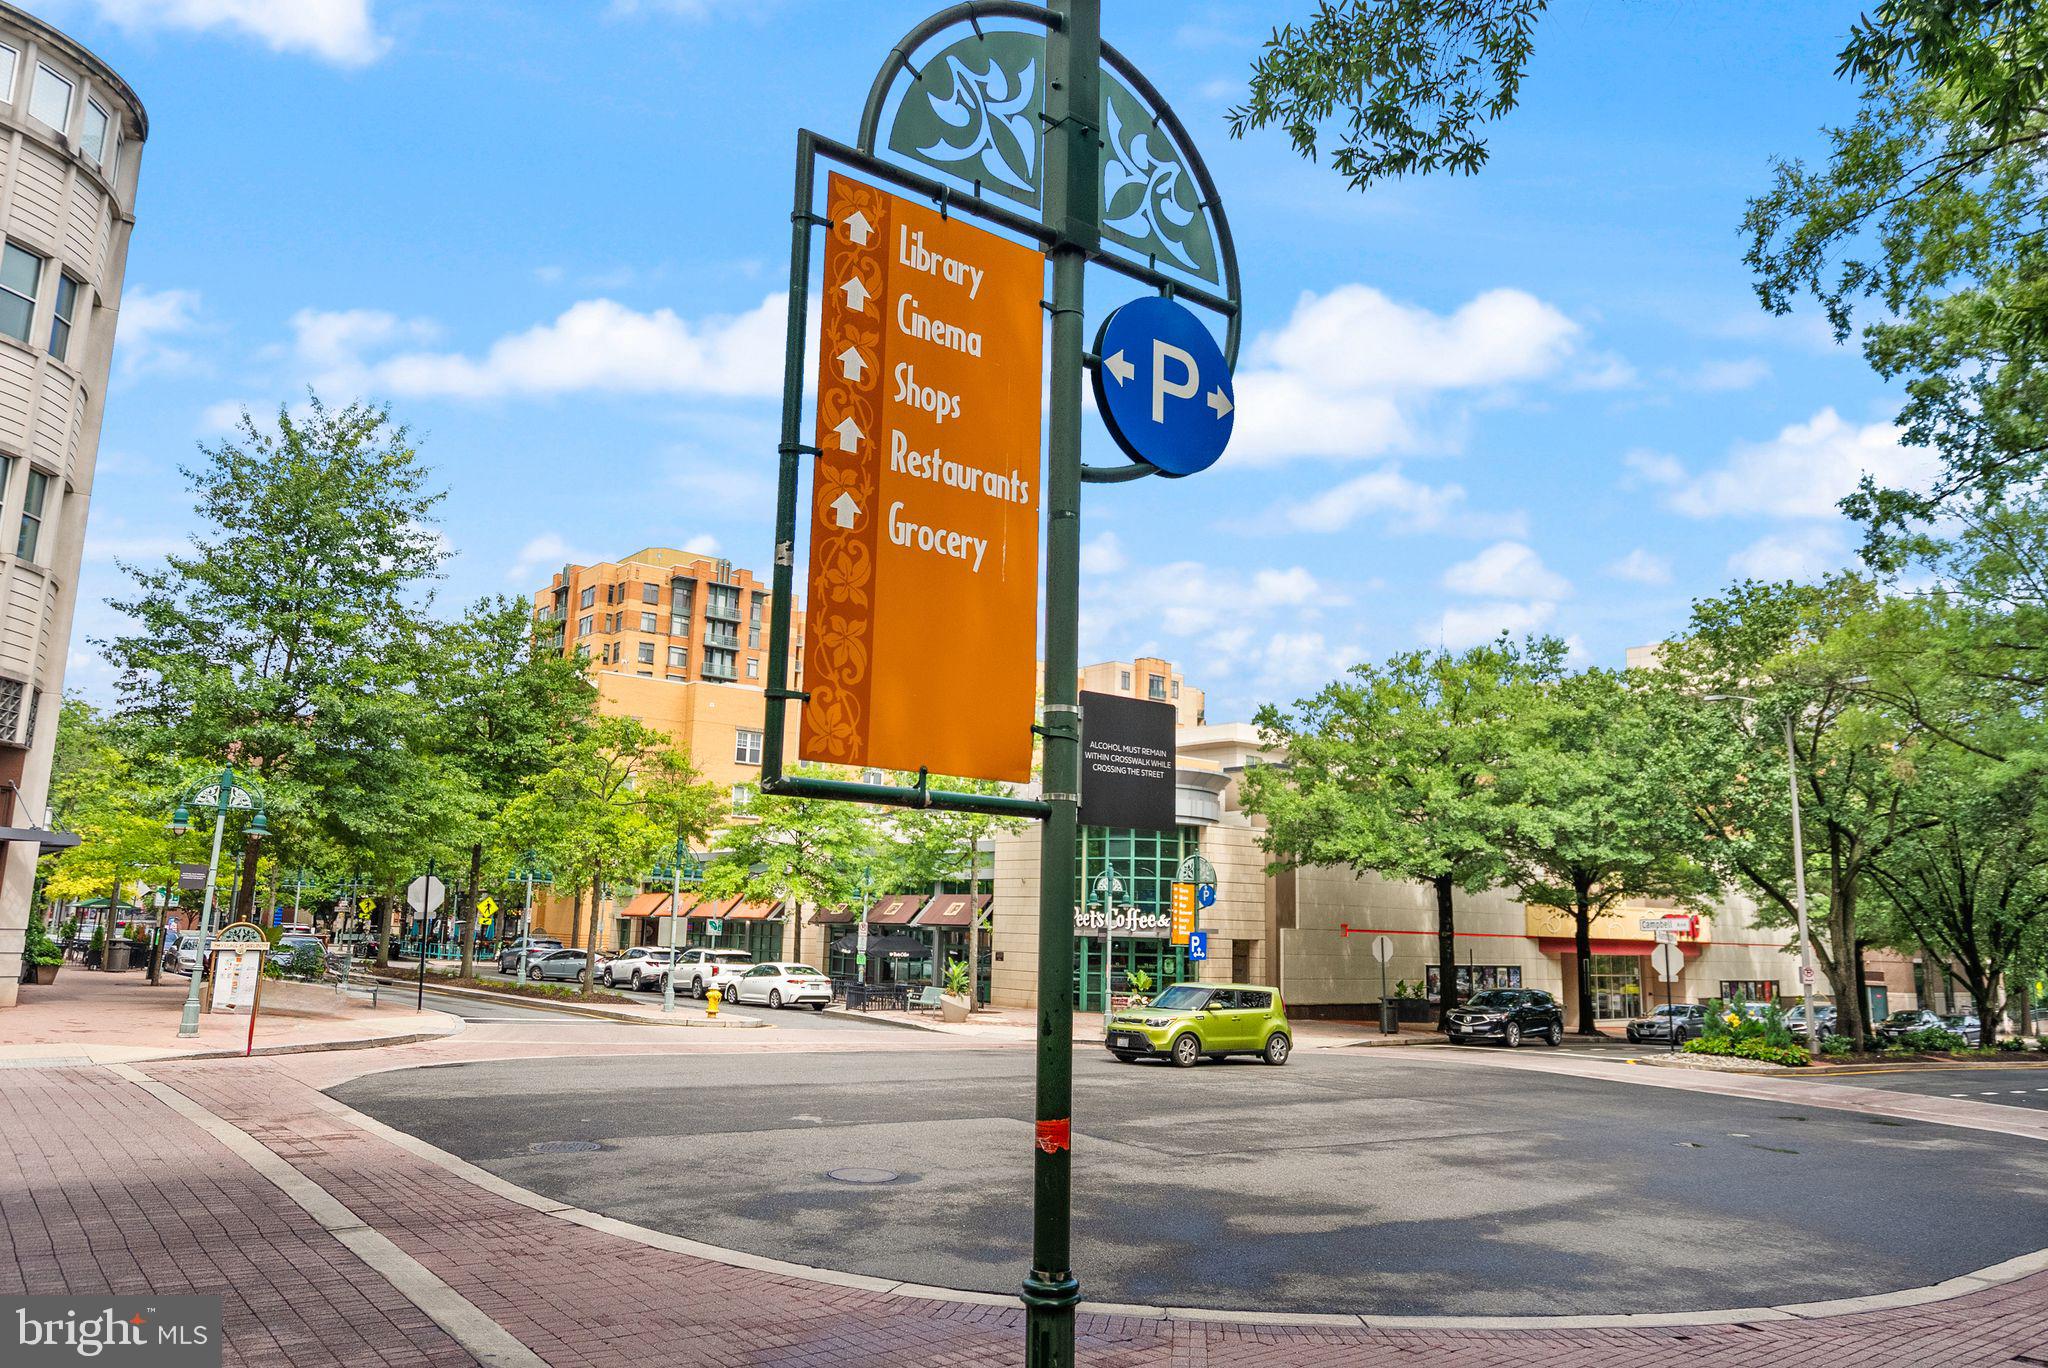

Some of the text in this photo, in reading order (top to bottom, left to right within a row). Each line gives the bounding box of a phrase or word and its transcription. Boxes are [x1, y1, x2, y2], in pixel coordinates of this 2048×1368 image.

[899, 224, 984, 300] Library
[897, 293, 982, 358] Cinema
[894, 362, 961, 424] Shops
[1152, 338, 1200, 424] P
[890, 429, 1029, 504] Restaurants
[888, 501, 988, 573] Grocery
[1084, 751, 1172, 769] WITHIN CROSSWALK WHILE
[1089, 741, 1167, 758] ALCOHOL MUST REMAIN
[1092, 763, 1165, 779] CROSSING THE STREET
[1203, 890, 1210, 902] P
[1106, 907, 1156, 931] Coffee
[1191, 935, 1200, 953] P
